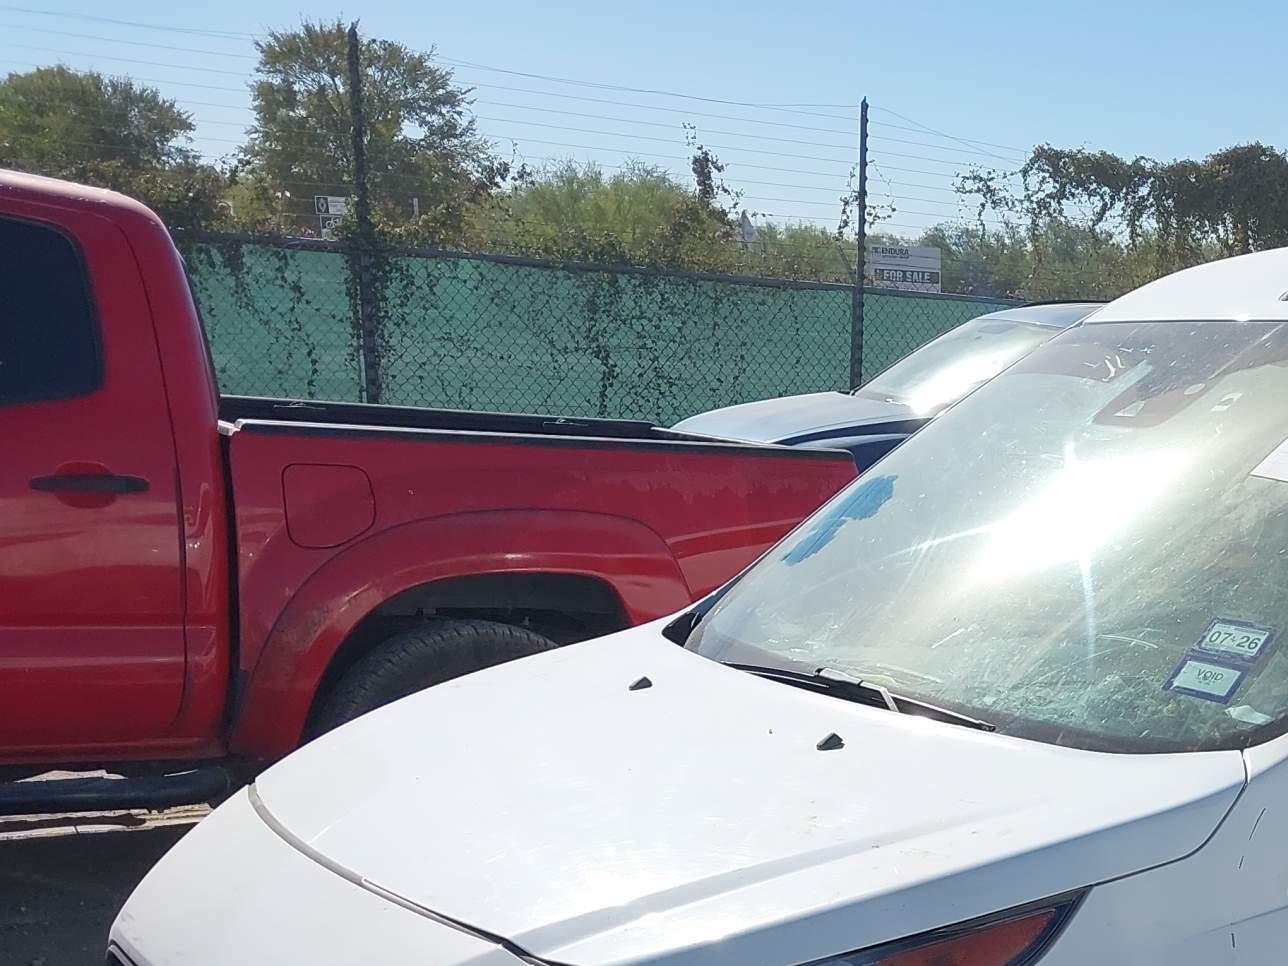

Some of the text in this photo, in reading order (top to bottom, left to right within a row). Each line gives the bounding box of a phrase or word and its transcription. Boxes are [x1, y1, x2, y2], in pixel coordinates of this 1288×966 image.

[883, 270, 931, 283] FOR SALE
[1197, 668, 1224, 681] VOID
